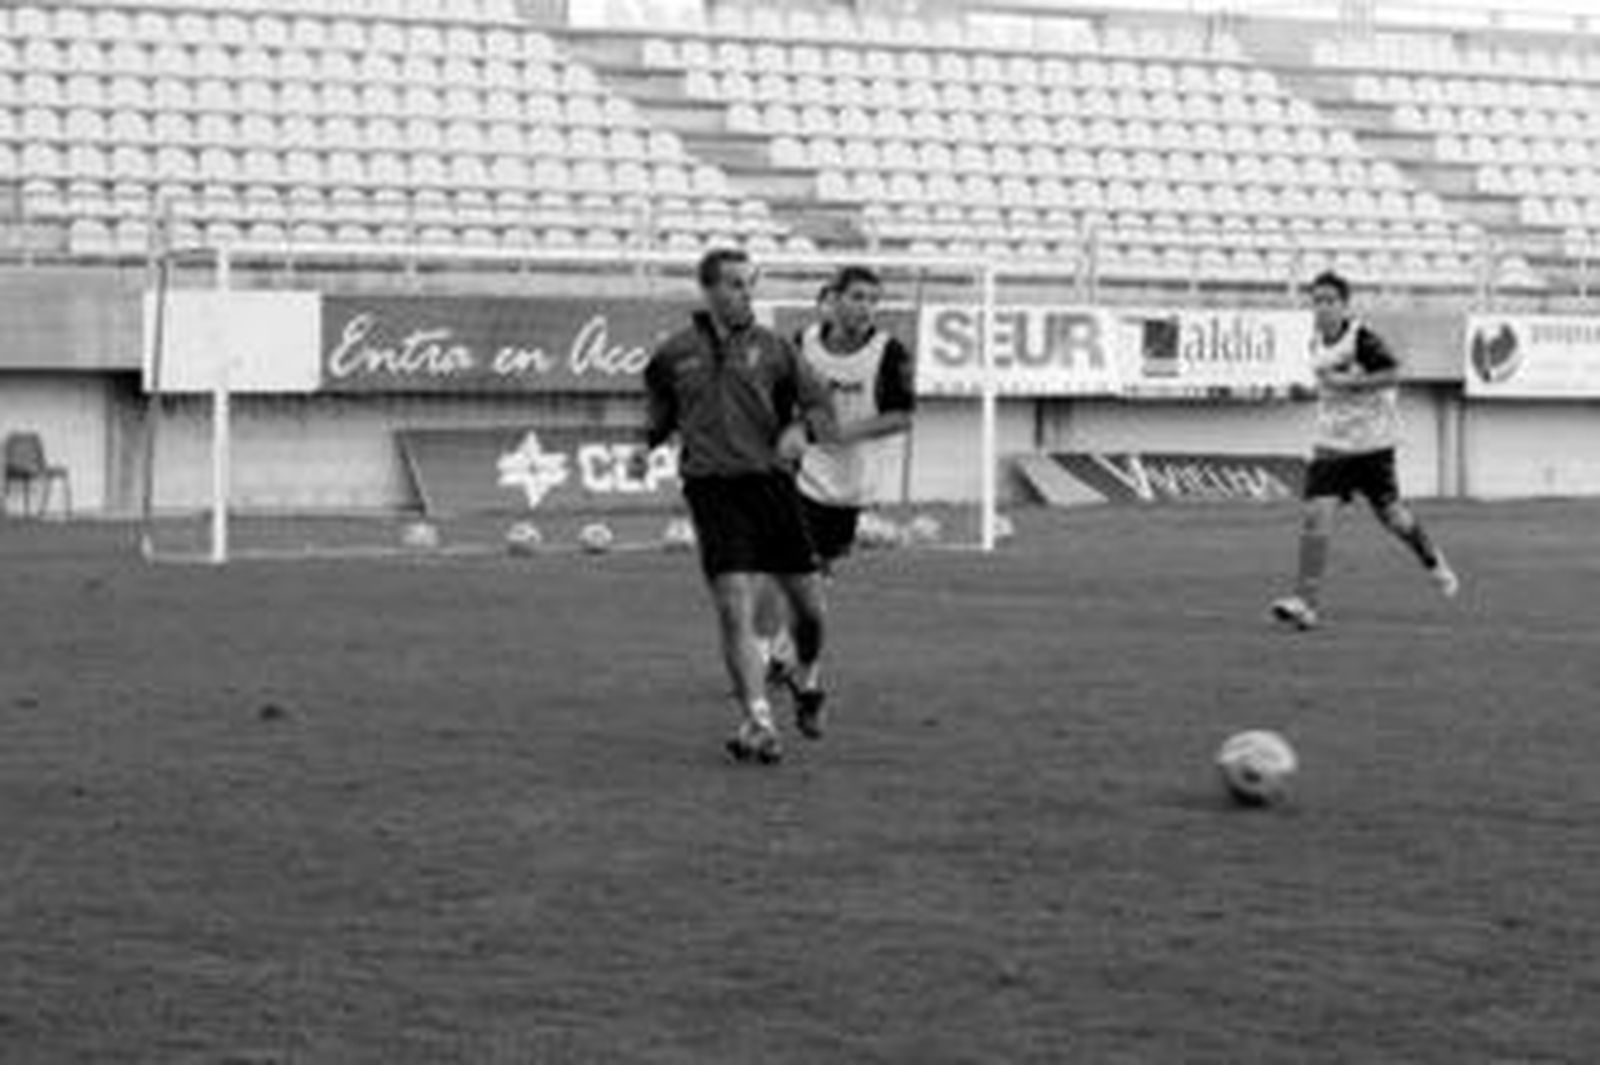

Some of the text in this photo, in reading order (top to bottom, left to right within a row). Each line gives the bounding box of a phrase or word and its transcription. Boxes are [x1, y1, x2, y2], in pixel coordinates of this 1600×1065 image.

[330, 312, 666, 377] Entra en Acc
[933, 311, 1105, 369] SEUR
